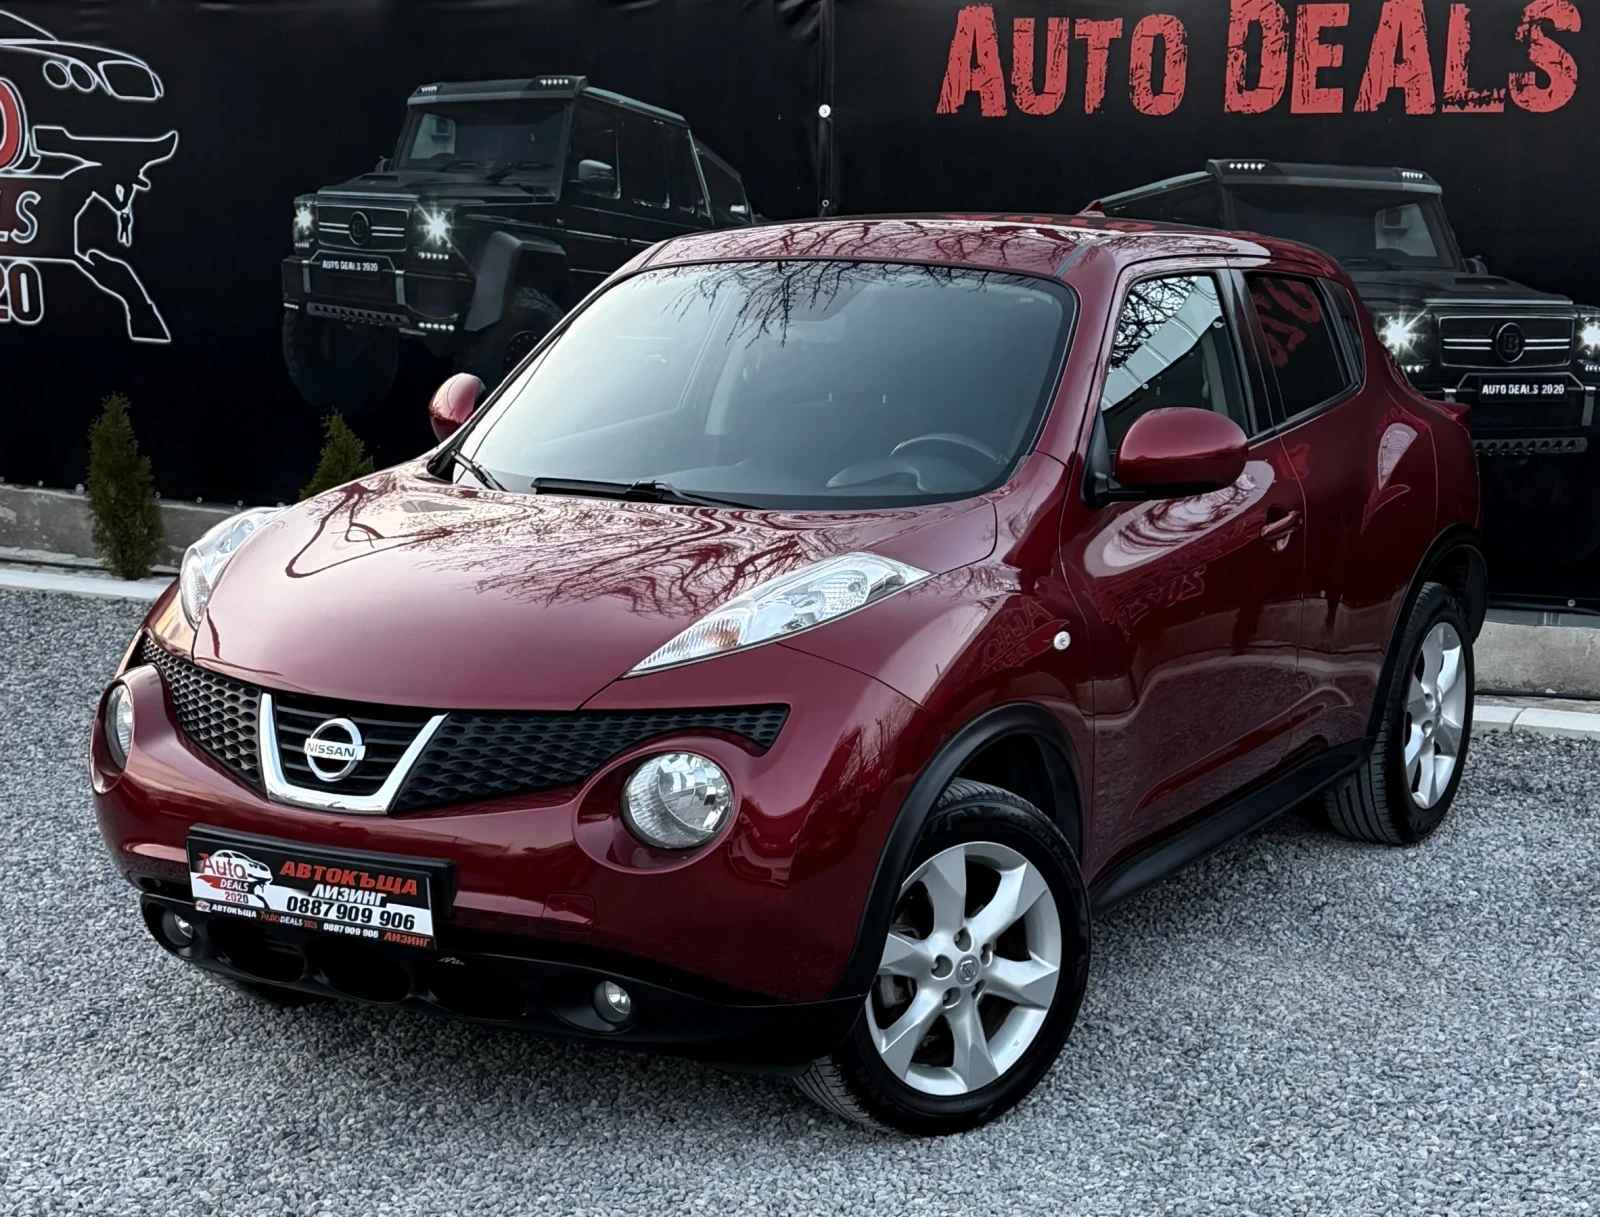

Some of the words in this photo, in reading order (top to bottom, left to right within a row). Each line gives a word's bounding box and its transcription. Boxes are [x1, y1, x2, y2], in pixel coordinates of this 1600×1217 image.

[937, 6, 1187, 117] AUTO
[1224, 0, 1582, 116] DEALS
[322, 260, 339, 269] AUTO
[340, 261, 361, 271] DEALS
[1482, 384, 1506, 394] AUTO
[1508, 384, 1538, 394] DEALS
[1542, 384, 1564, 394] 2020
[306, 742, 355, 758] NISSAN
[198, 852, 248, 880] Auto
[220, 879, 249, 892] DEALS
[280, 860, 417, 896] АВТОКЪЩА
[225, 892, 249, 904] 2020
[311, 884, 387, 906] ЛИЗИНГ
[380, 910, 415, 930] 906
